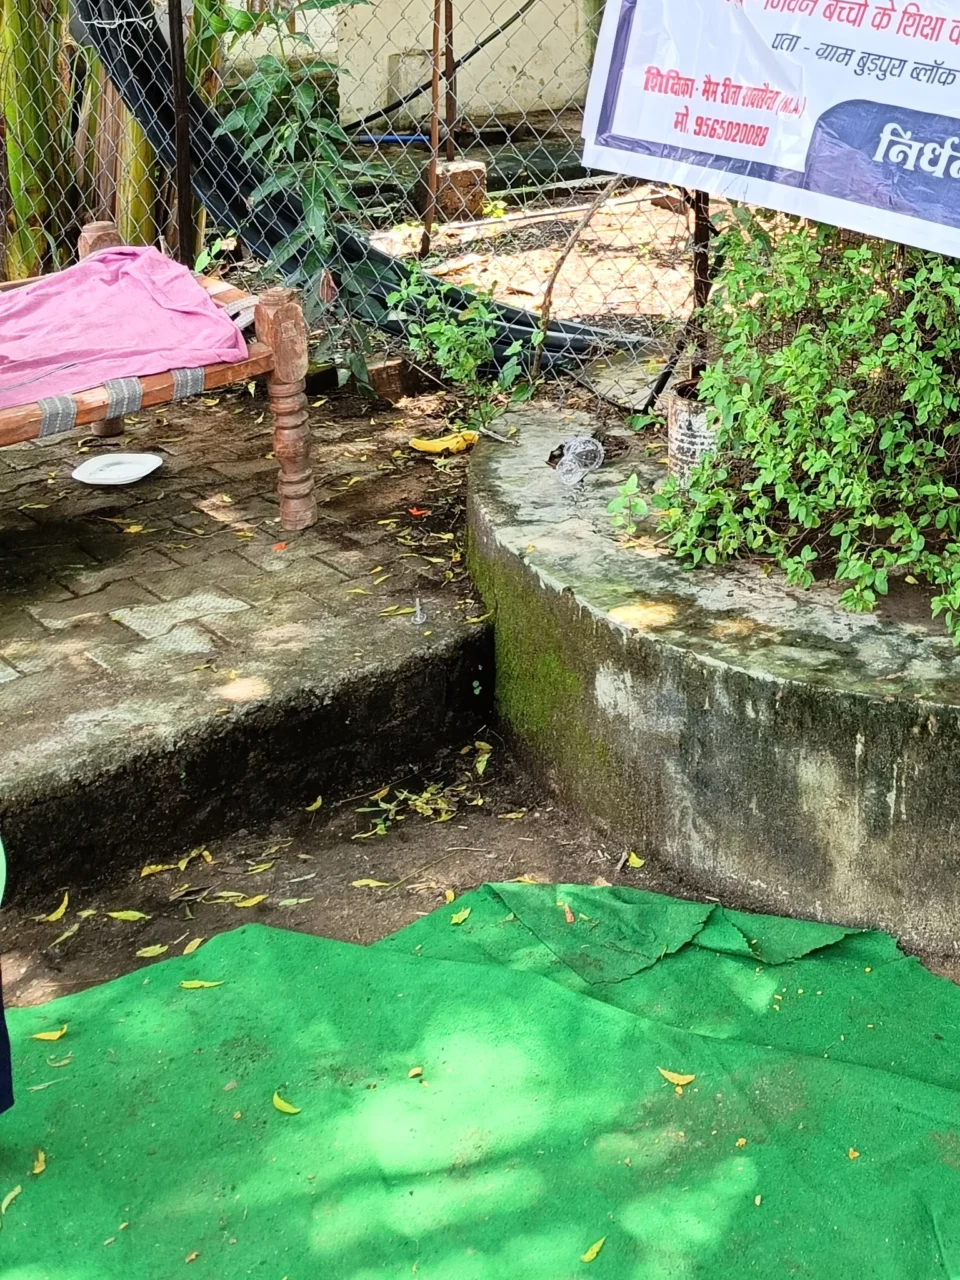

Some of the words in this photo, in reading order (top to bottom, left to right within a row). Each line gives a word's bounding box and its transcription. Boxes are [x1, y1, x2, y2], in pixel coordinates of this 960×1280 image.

[895, 2, 947, 42] शिक्षा
[771, 33, 801, 53] पता
[815, 42, 856, 67] ग्राम
[910, 59, 960, 86] ब्लॉक
[693, 115, 770, 147] 9565020088
